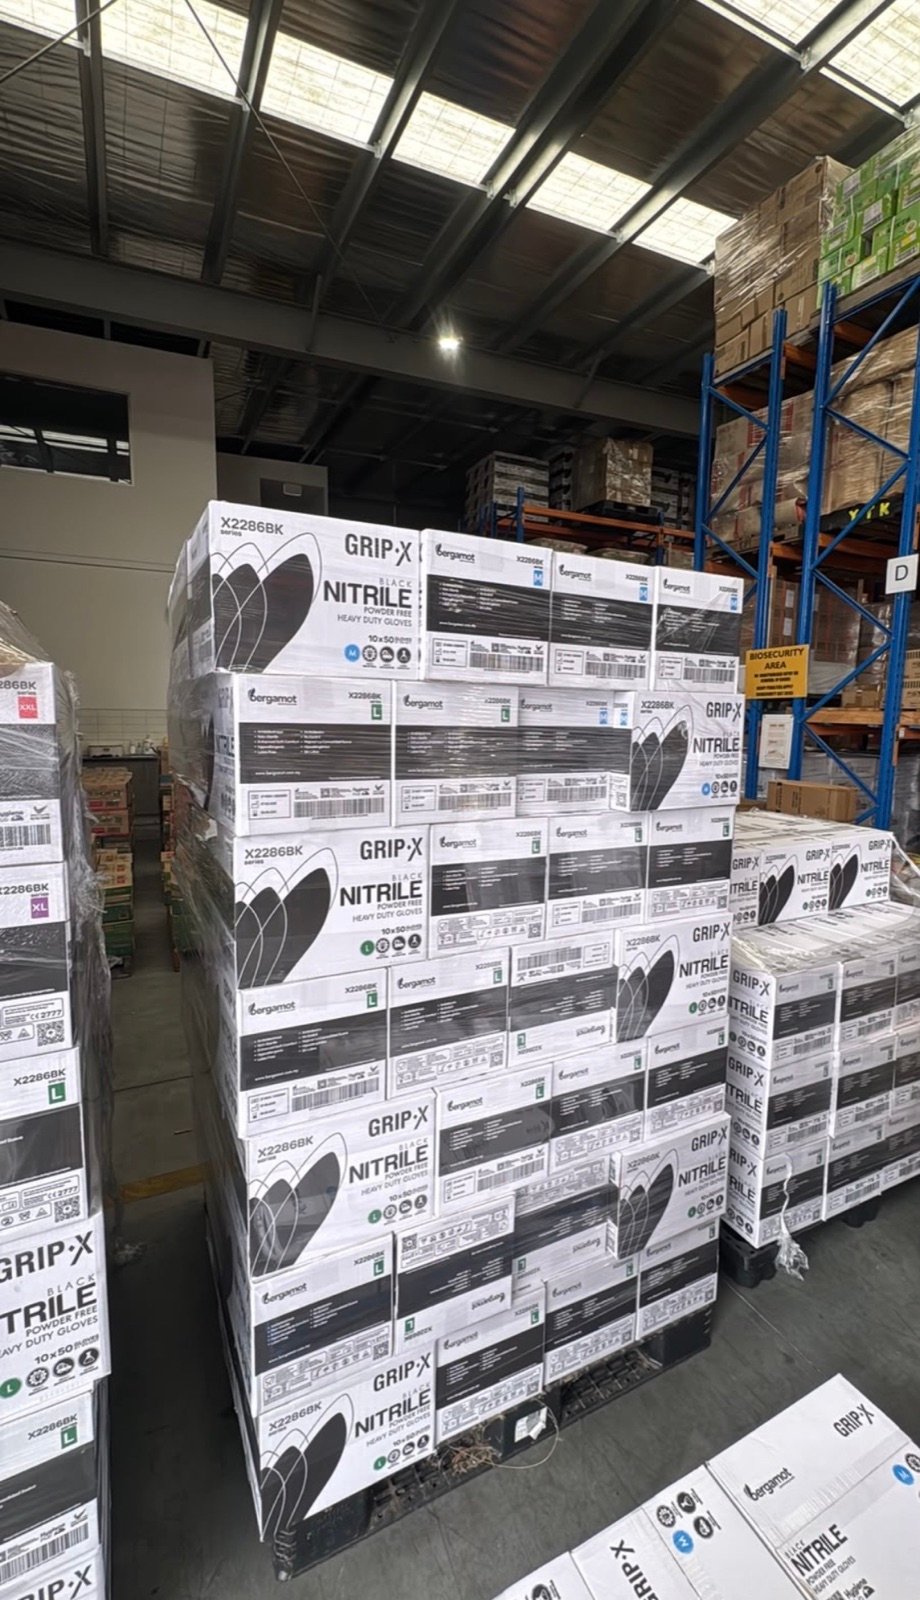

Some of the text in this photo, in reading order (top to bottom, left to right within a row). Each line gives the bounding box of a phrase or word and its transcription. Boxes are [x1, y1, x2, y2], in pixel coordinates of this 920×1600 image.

[220, 516, 284, 536] X2286BK
[220, 529, 242, 537] series
[436, 543, 475, 563] bergamot
[559, 564, 592, 581] bergamot
[896, 565, 908, 581] D
[379, 577, 412, 588] BLACK
[323, 580, 412, 609] NITRILE
[363, 606, 412, 618] POWDER FREE
[337, 614, 412, 627] HEAVY DUTY GLOVES
[368, 635, 394, 644] 10x50
[749, 648, 804, 660] BIOSECURITY
[765, 661, 786, 669] AREA
[248, 688, 297, 705] bergamot
[404, 694, 443, 709] bergamot
[641, 700, 675, 709] X2286BK
[19, 703, 37, 711] XXL
[520, 699, 553, 712] bergamot
[693, 738, 740, 753] NITRILE
[556, 827, 587, 838] bergamot
[440, 836, 476, 848] bergamot
[244, 845, 303, 859] X2286BK
[861, 860, 890, 873] NITRILE
[392, 872, 423, 882] BLACK
[797, 870, 829, 885] NITRILE
[340, 880, 423, 907] NITRILE
[730, 880, 758, 892] ITRILE
[32, 903, 48, 912] XL
[377, 901, 406, 910] POWDER
[352, 908, 423, 922] HEAVY DUTY GLOVES
[382, 926, 405, 935] 10x50
[680, 954, 729, 978] NITRILE
[397, 976, 436, 989] bergamot
[41, 1010, 62, 1018] 2777
[249, 1002, 296, 1016] bergamot
[728, 996, 768, 1024] ITRILE
[14, 1068, 66, 1086] X2286BK
[51, 1087, 63, 1100] L
[726, 1083, 763, 1114] ITRILE
[448, 1097, 483, 1112] bergamot
[257, 1136, 314, 1158] X2286BK
[399, 1138, 428, 1150] BLACK
[350, 1145, 428, 1184] NITRILE
[385, 1162, 428, 1180] POWDER FREE
[678, 1156, 726, 1188] NITRILE
[58, 1186, 78, 1196] 2777
[361, 1170, 428, 1196] HEAVY DUTY GLOVES
[47, 1273, 96, 1297] BLACK
[262, 1283, 307, 1305] bergamot
[26, 1305, 98, 1337] POWDER FREE
[25, 1332, 54, 1349] DUTY
[57, 1316, 98, 1336] GLOVES
[444, 1331, 478, 1350] bergamot
[34, 1344, 73, 1364] 10x50
[402, 1382, 431, 1400] BLACK
[268, 1401, 322, 1432] X2286BK
[355, 1387, 431, 1438] NITRILE
[388, 1405, 431, 1428] POWDER FREE
[28, 1413, 78, 1440] X2286BK
[366, 1412, 431, 1447] HEAVY DUTY GLOVES
[744, 1467, 795, 1502] bergamot
[791, 1523, 849, 1577] NITRILE
[844, 1578, 868, 1600] Hygiene
